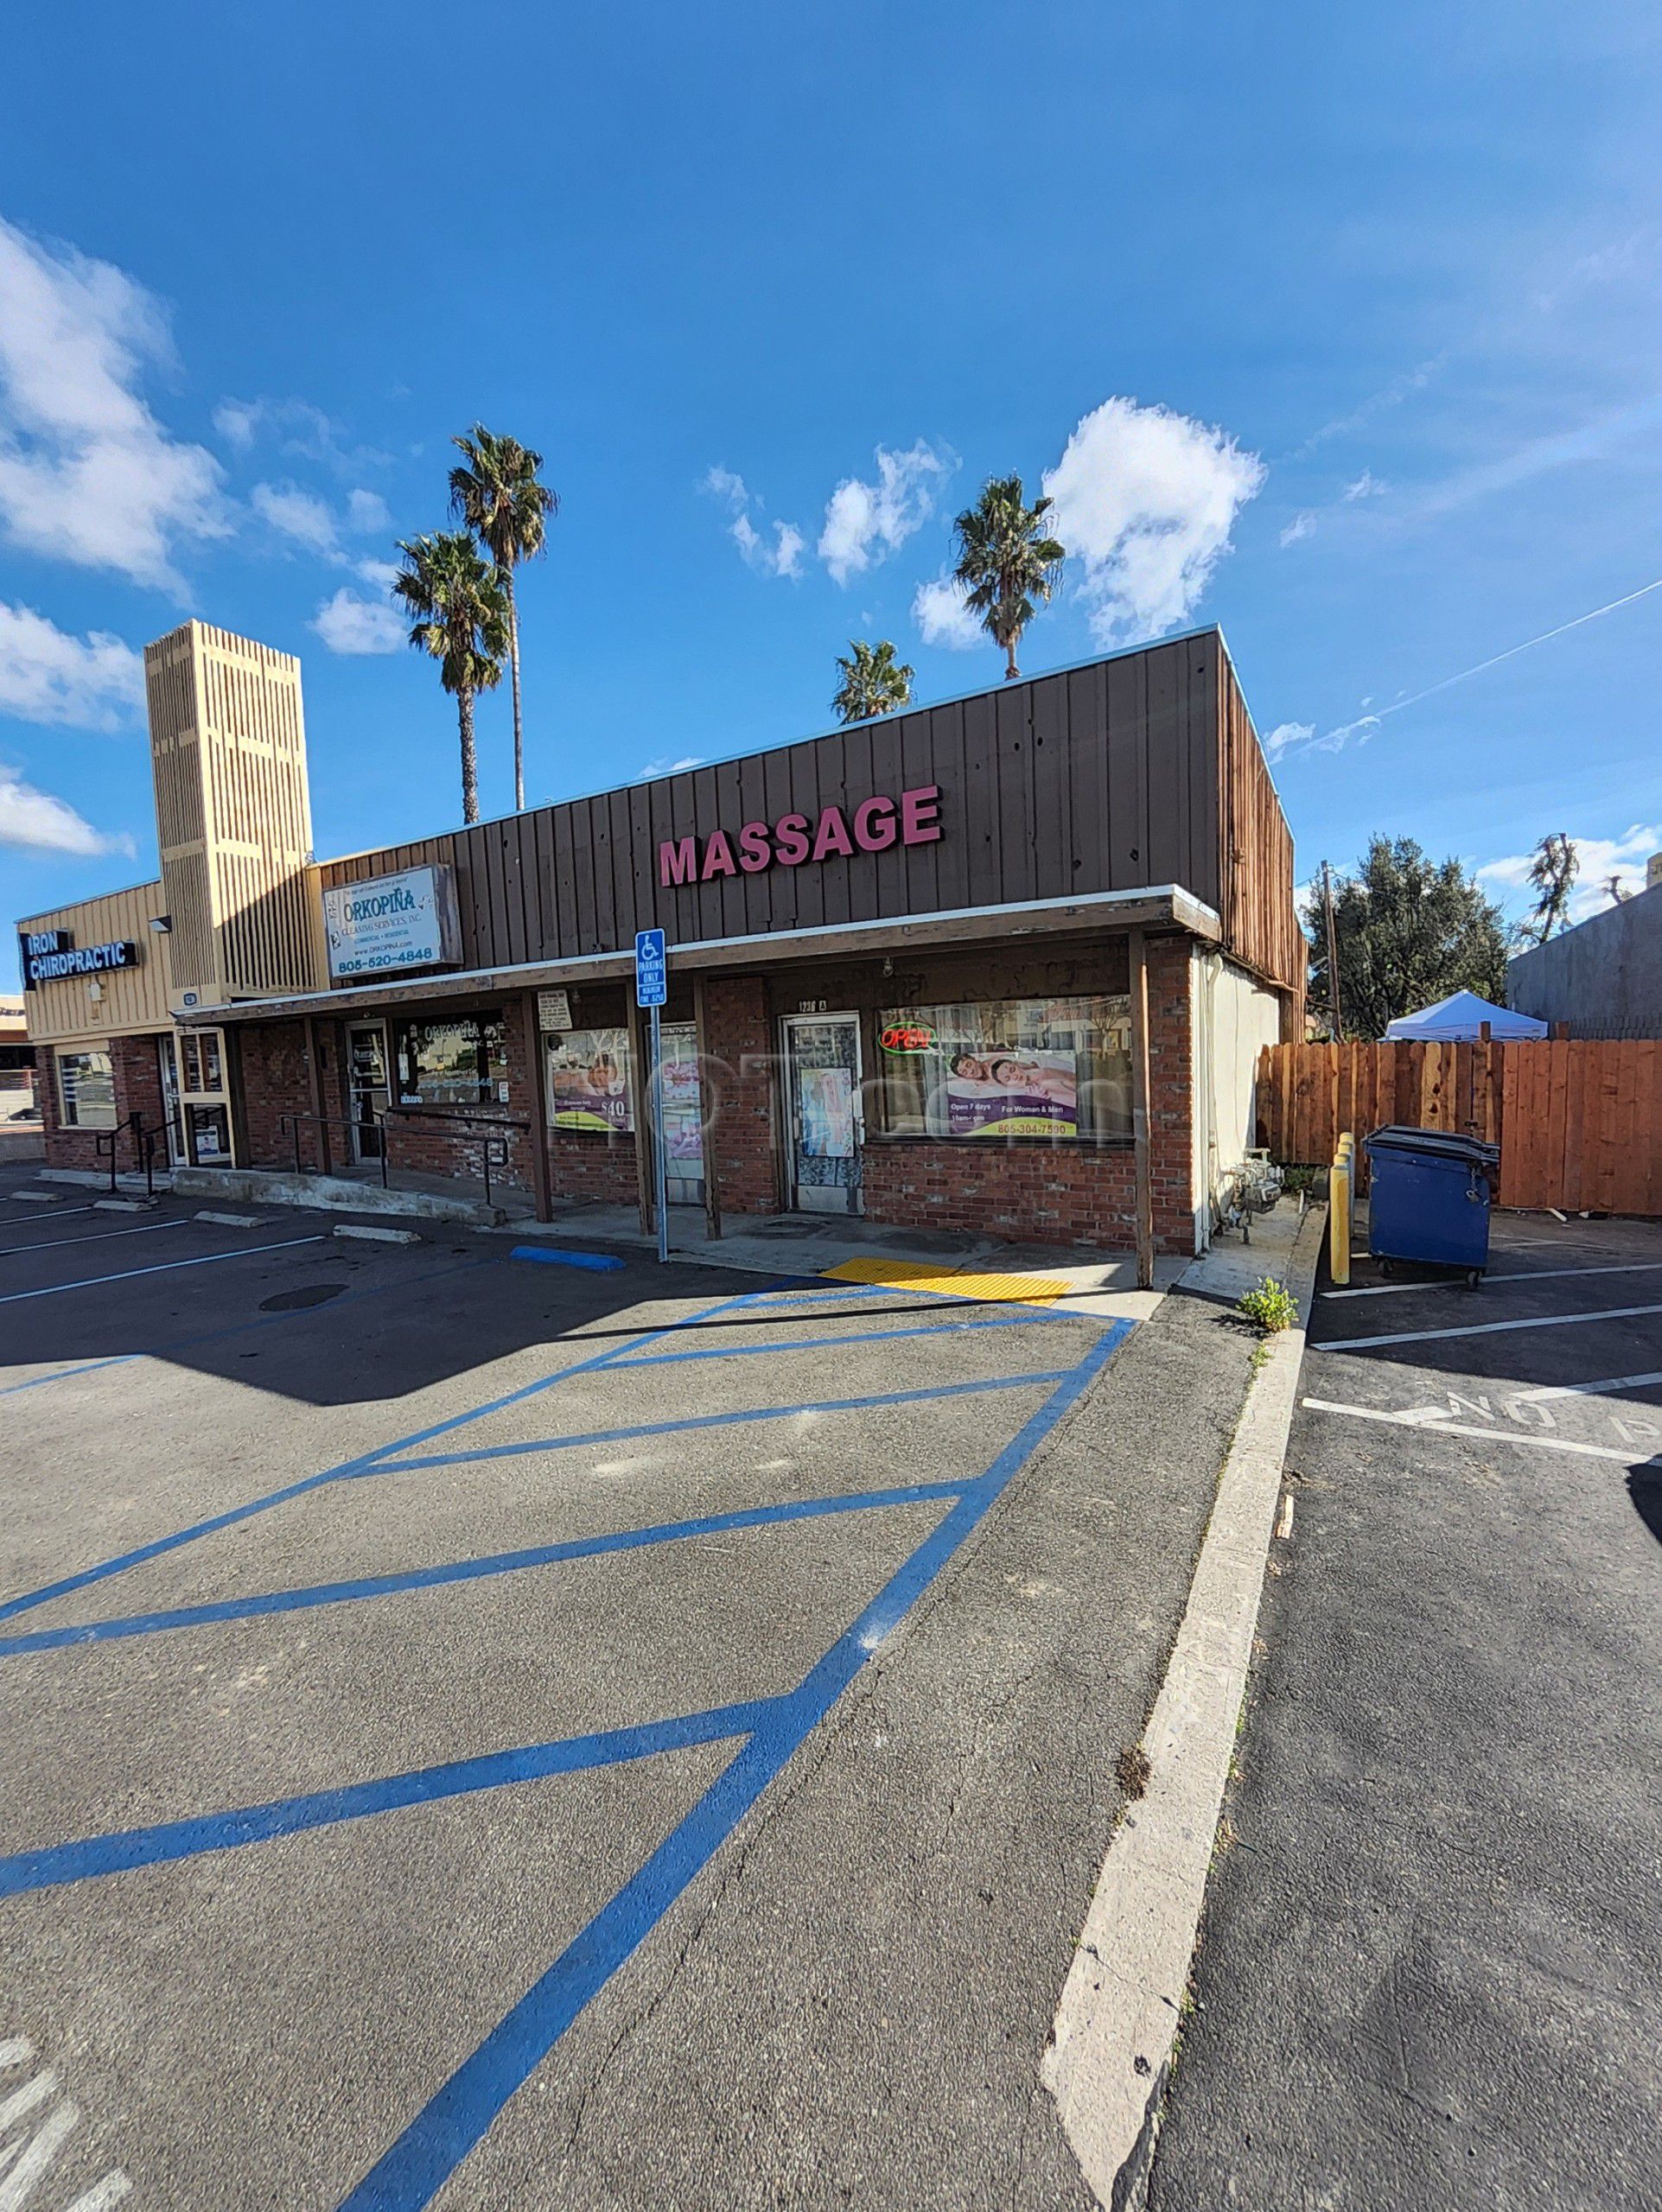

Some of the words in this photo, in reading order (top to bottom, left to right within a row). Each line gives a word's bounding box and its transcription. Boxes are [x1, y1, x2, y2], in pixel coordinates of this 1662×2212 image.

[659, 785, 941, 887] MASSAGE
[343, 887, 416, 923] ORKOPIÑA
[341, 925, 373, 937] CLEANING
[28, 931, 59, 956] IRON
[30, 941, 126, 981] CHIROPRACTIC
[338, 947, 432, 974] 805-520-4848
[639, 958, 663, 973] PARKING
[643, 971, 659, 983] ONLY
[819, 1001, 827, 1010] A
[882, 1027, 933, 1048] OPEN
[601, 1100, 625, 1116] $40
[997, 1123, 1067, 1135] 805-304-7590
